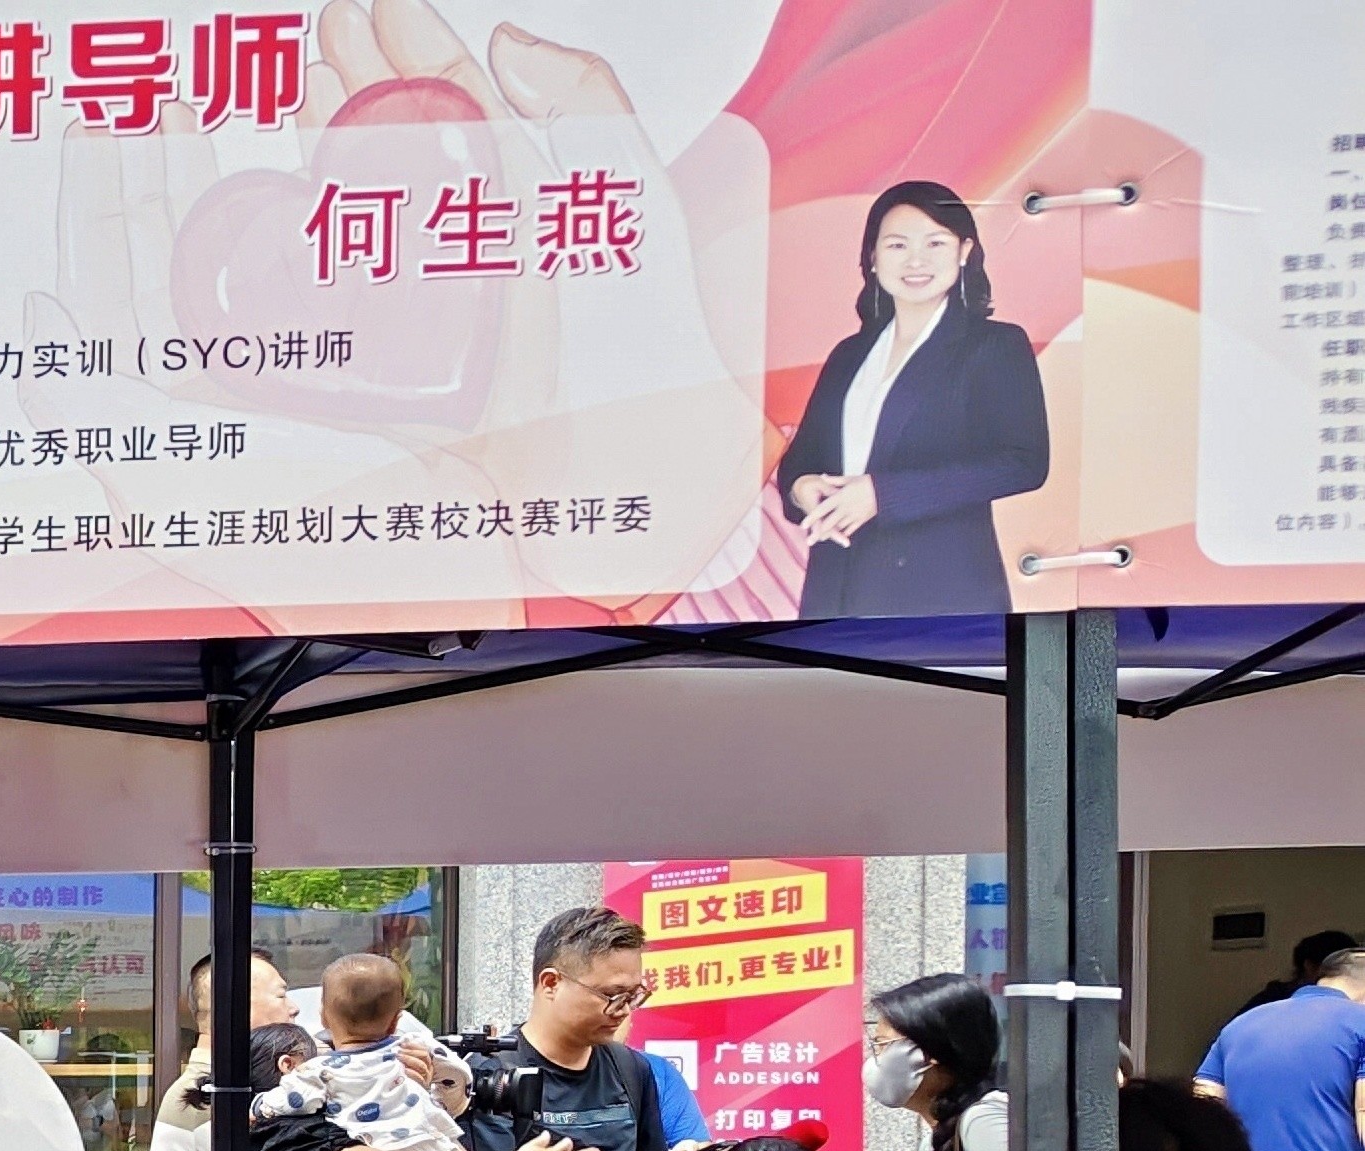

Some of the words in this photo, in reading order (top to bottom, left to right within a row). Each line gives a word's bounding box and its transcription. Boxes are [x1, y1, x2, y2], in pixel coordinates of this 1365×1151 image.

[306, 171, 640, 282] 何生燕
[661, 886, 803, 930] 图文速印
[714, 1041, 819, 1064] 广告设计
[714, 1072, 819, 1085] ADDESIGN
